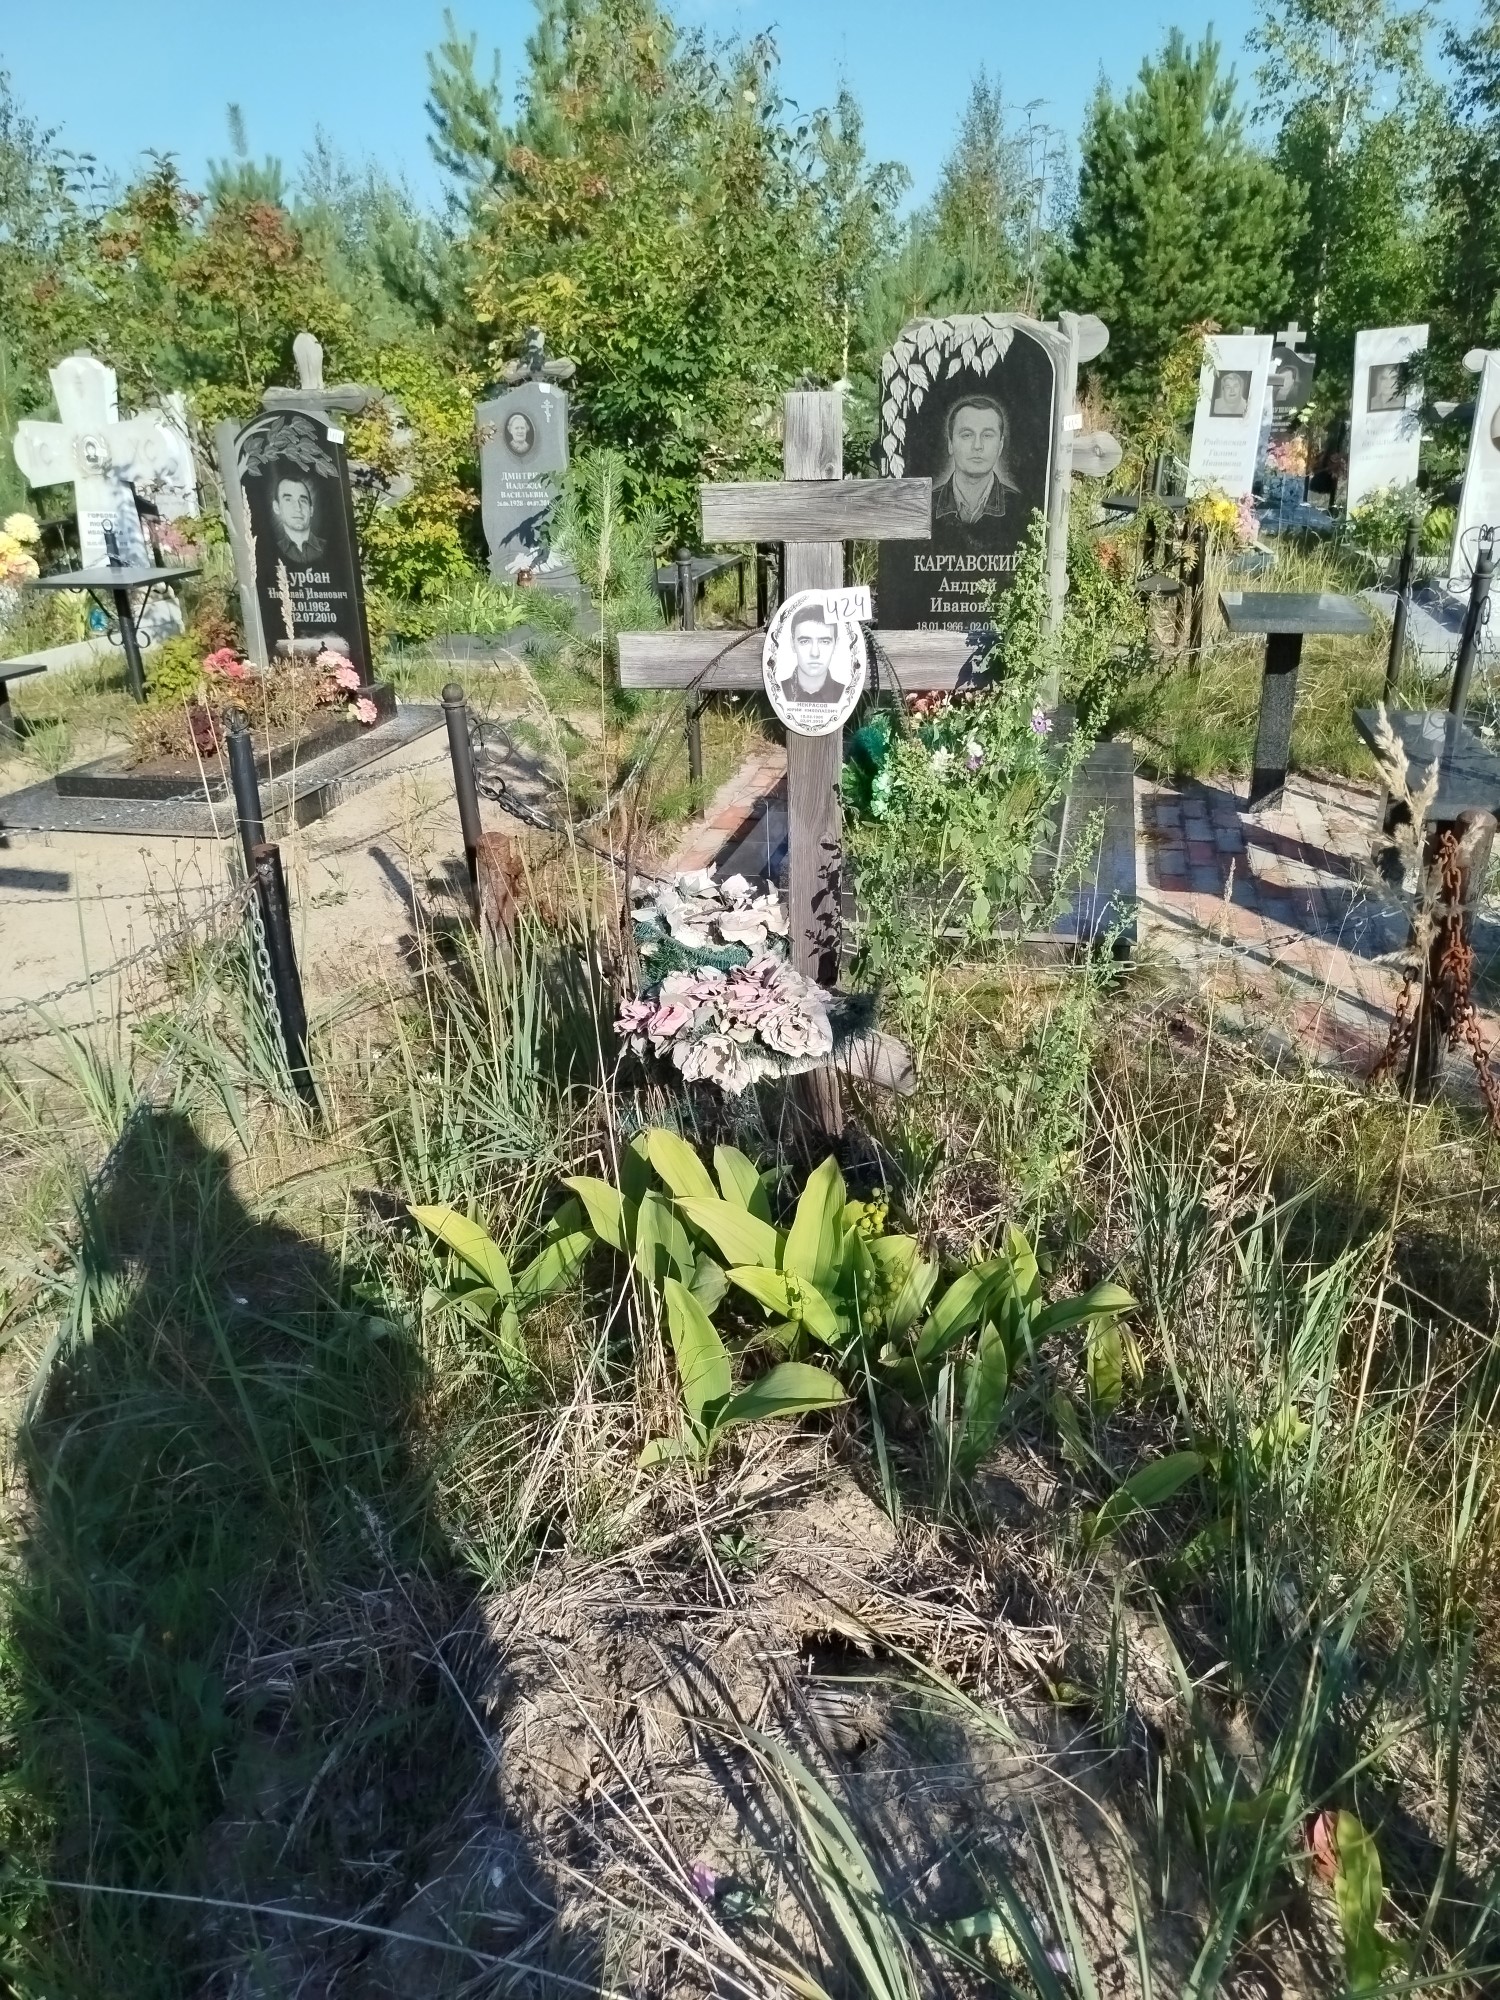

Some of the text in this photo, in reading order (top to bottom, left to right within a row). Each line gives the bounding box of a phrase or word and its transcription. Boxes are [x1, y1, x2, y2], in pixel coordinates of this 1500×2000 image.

[501, 471, 543, 482] ДМИТРИ
[280, 567, 331, 587] урбан
[938, 577, 998, 595] Андрй
[305, 587, 348, 600] Иванович
[826, 593, 865, 621] 424
